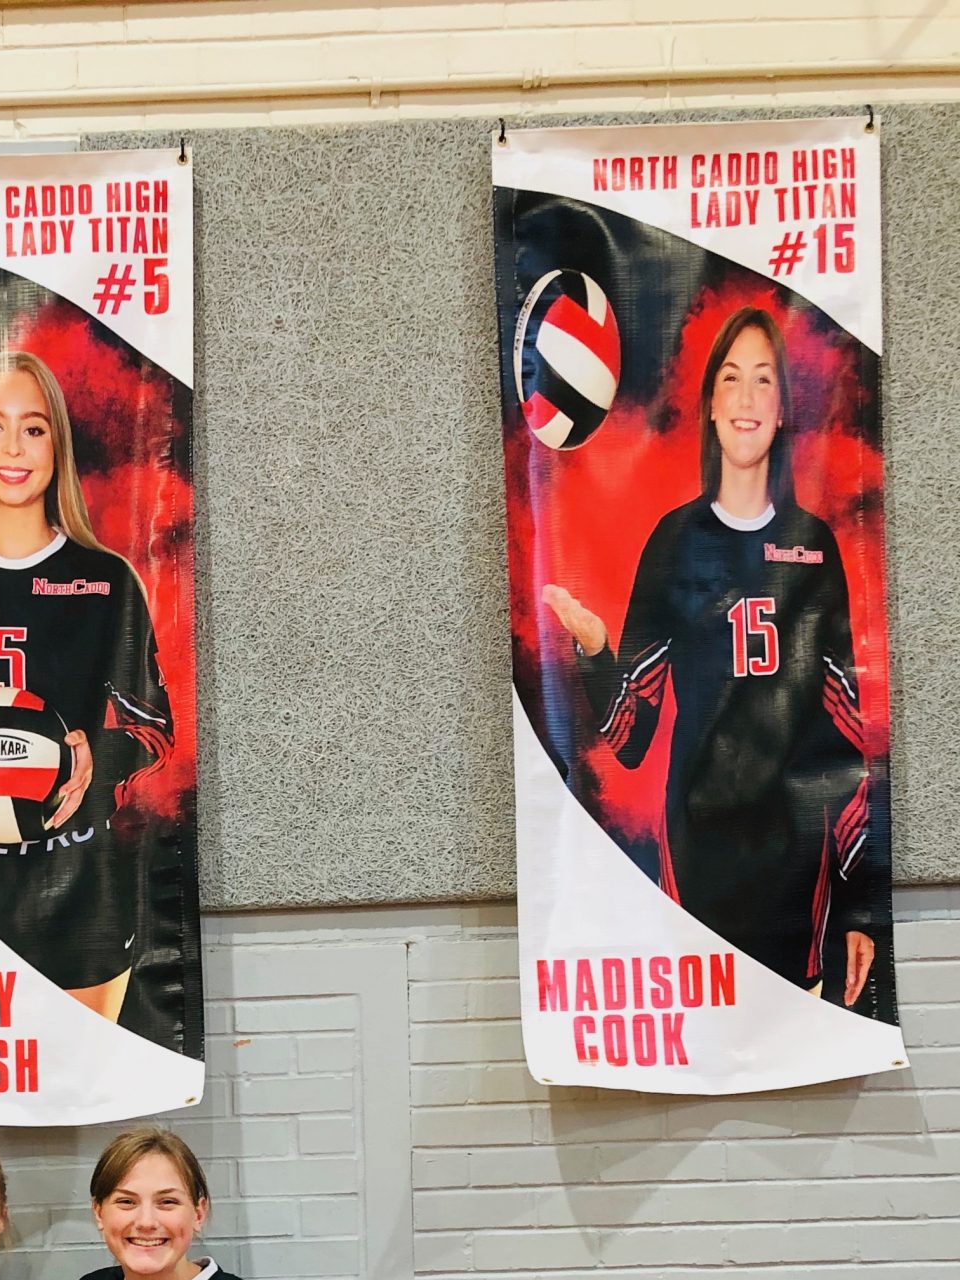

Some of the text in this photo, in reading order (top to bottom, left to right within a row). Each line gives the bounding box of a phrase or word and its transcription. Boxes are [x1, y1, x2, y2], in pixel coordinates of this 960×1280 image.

[593, 148, 856, 191] NORTH CADDO HIGH
[5, 183, 92, 218] CADDO
[106, 180, 168, 213] HIGH
[690, 183, 857, 229] LADY TITAN
[5, 217, 168, 257] LADY TITAN
[768, 223, 856, 277] #15
[92, 258, 170, 315] #5
[727, 597, 779, 677] 15
[536, 953, 736, 1012] MADISON
[573, 1012, 689, 1067] COOK
